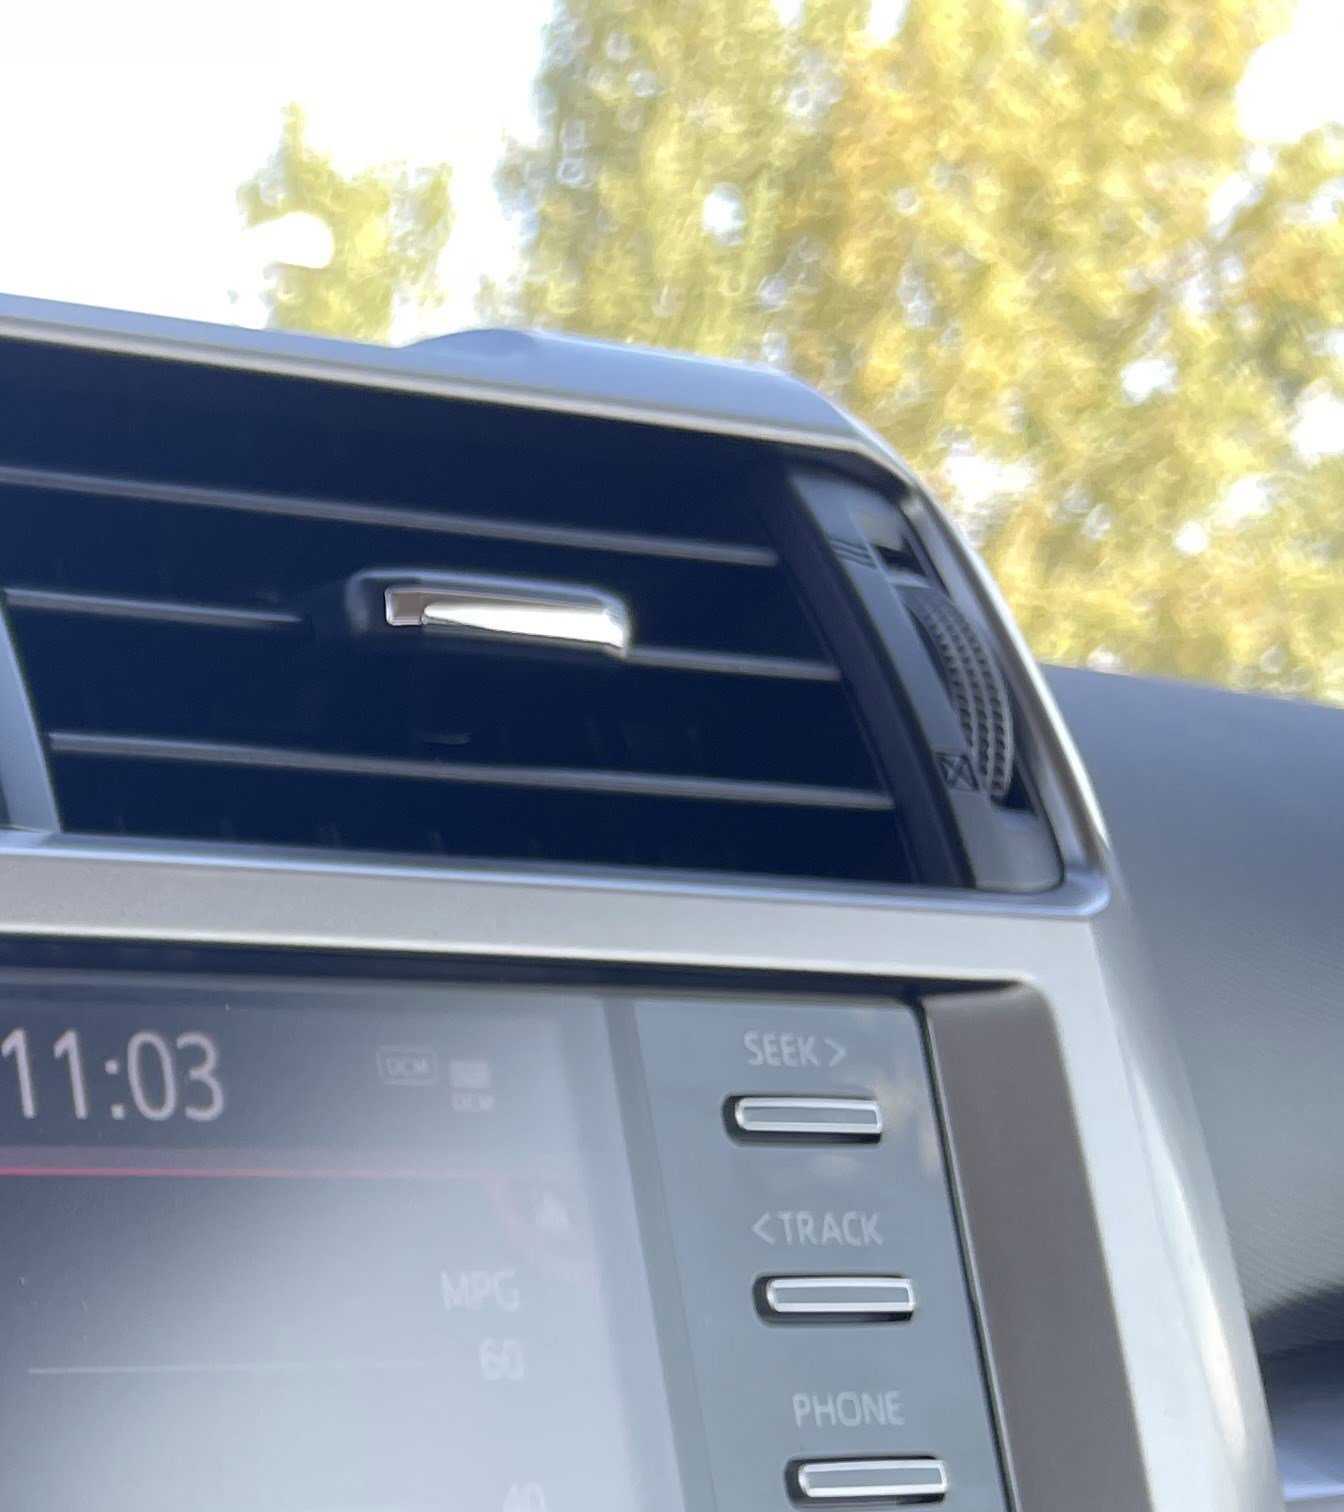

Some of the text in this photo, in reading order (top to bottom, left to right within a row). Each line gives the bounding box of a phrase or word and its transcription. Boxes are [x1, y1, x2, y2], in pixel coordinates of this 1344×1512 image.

[0, 1028, 226, 1121] 11:03
[440, 1268, 521, 1313] MPG
[478, 1336, 525, 1382] 60
[792, 1390, 906, 1428] PHONE
